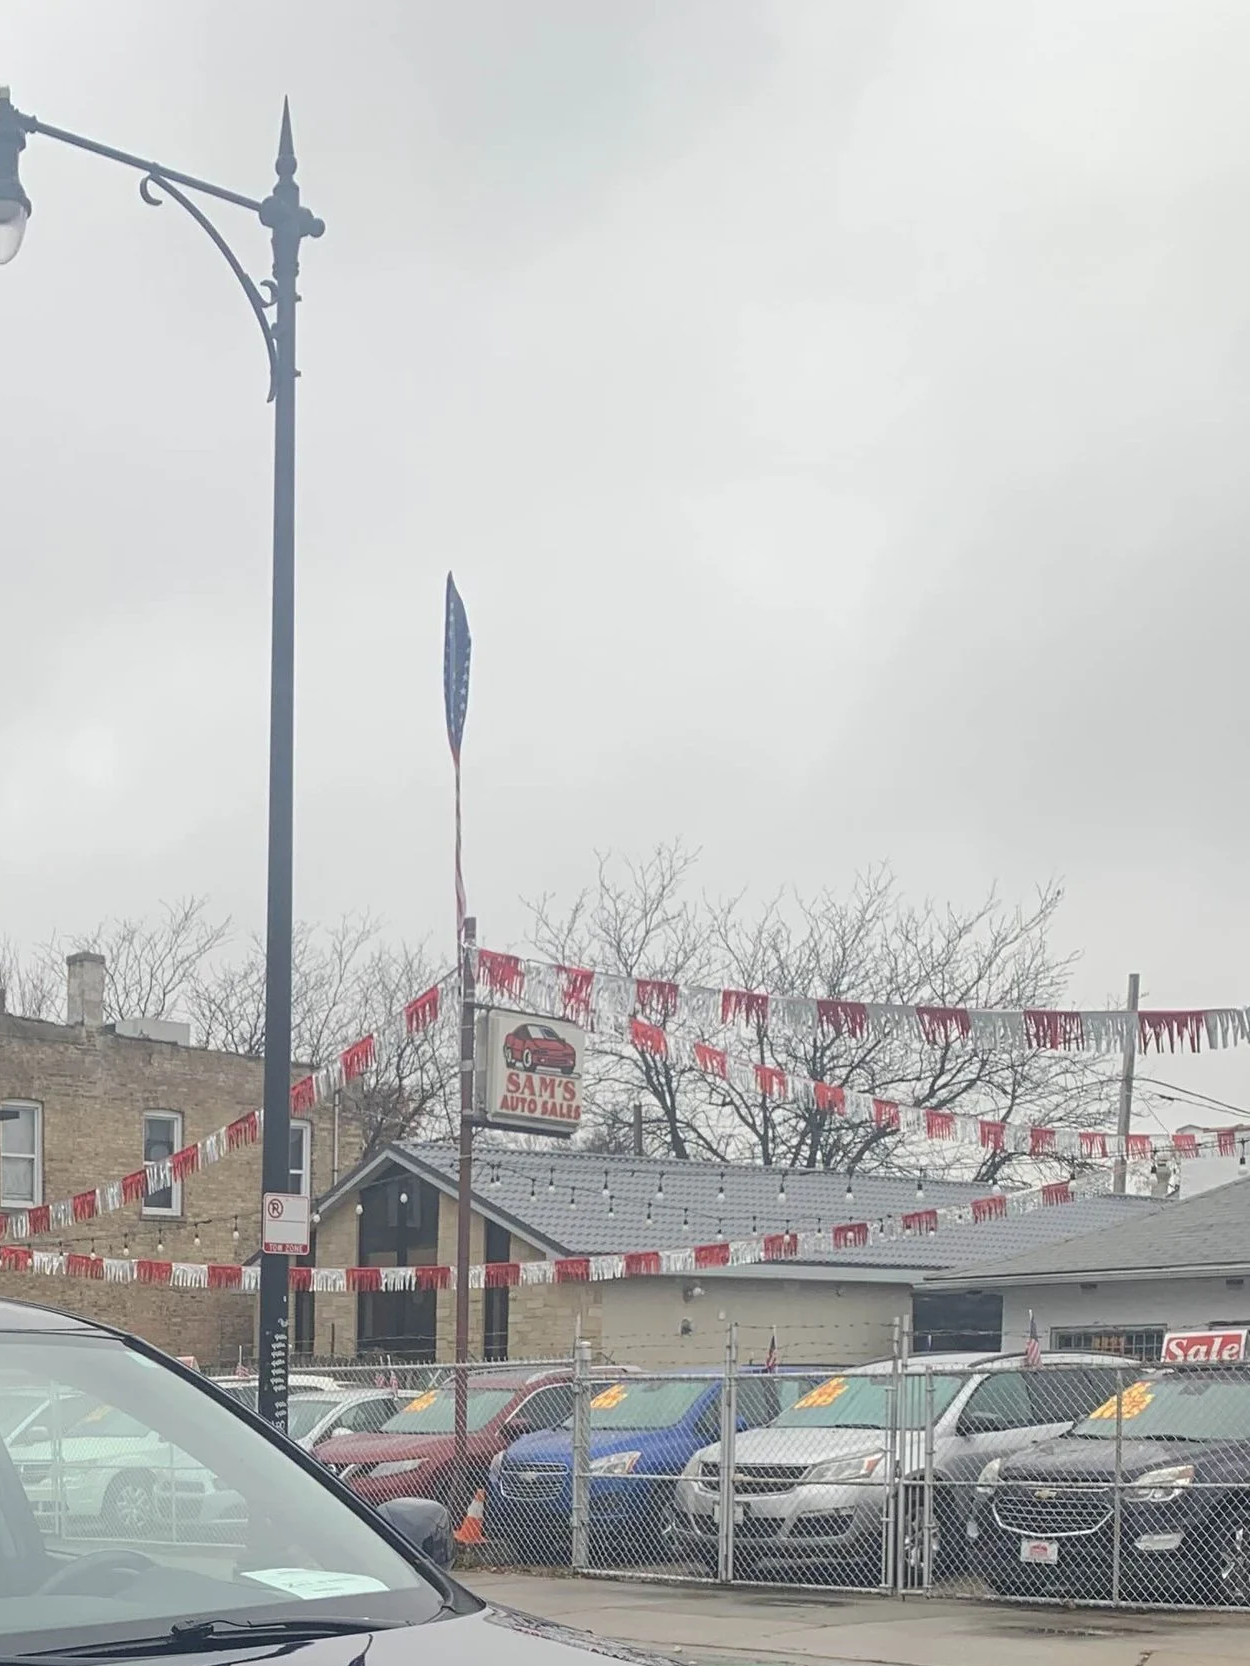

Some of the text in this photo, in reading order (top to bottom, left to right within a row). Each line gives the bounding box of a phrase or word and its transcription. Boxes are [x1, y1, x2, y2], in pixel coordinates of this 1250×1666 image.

[506, 1072, 577, 1102] SAM'S
[500, 1094, 581, 1121] AUTO SALES
[286, 1244, 303, 1253] ZONE
[1166, 1336, 1240, 1363] Sale
